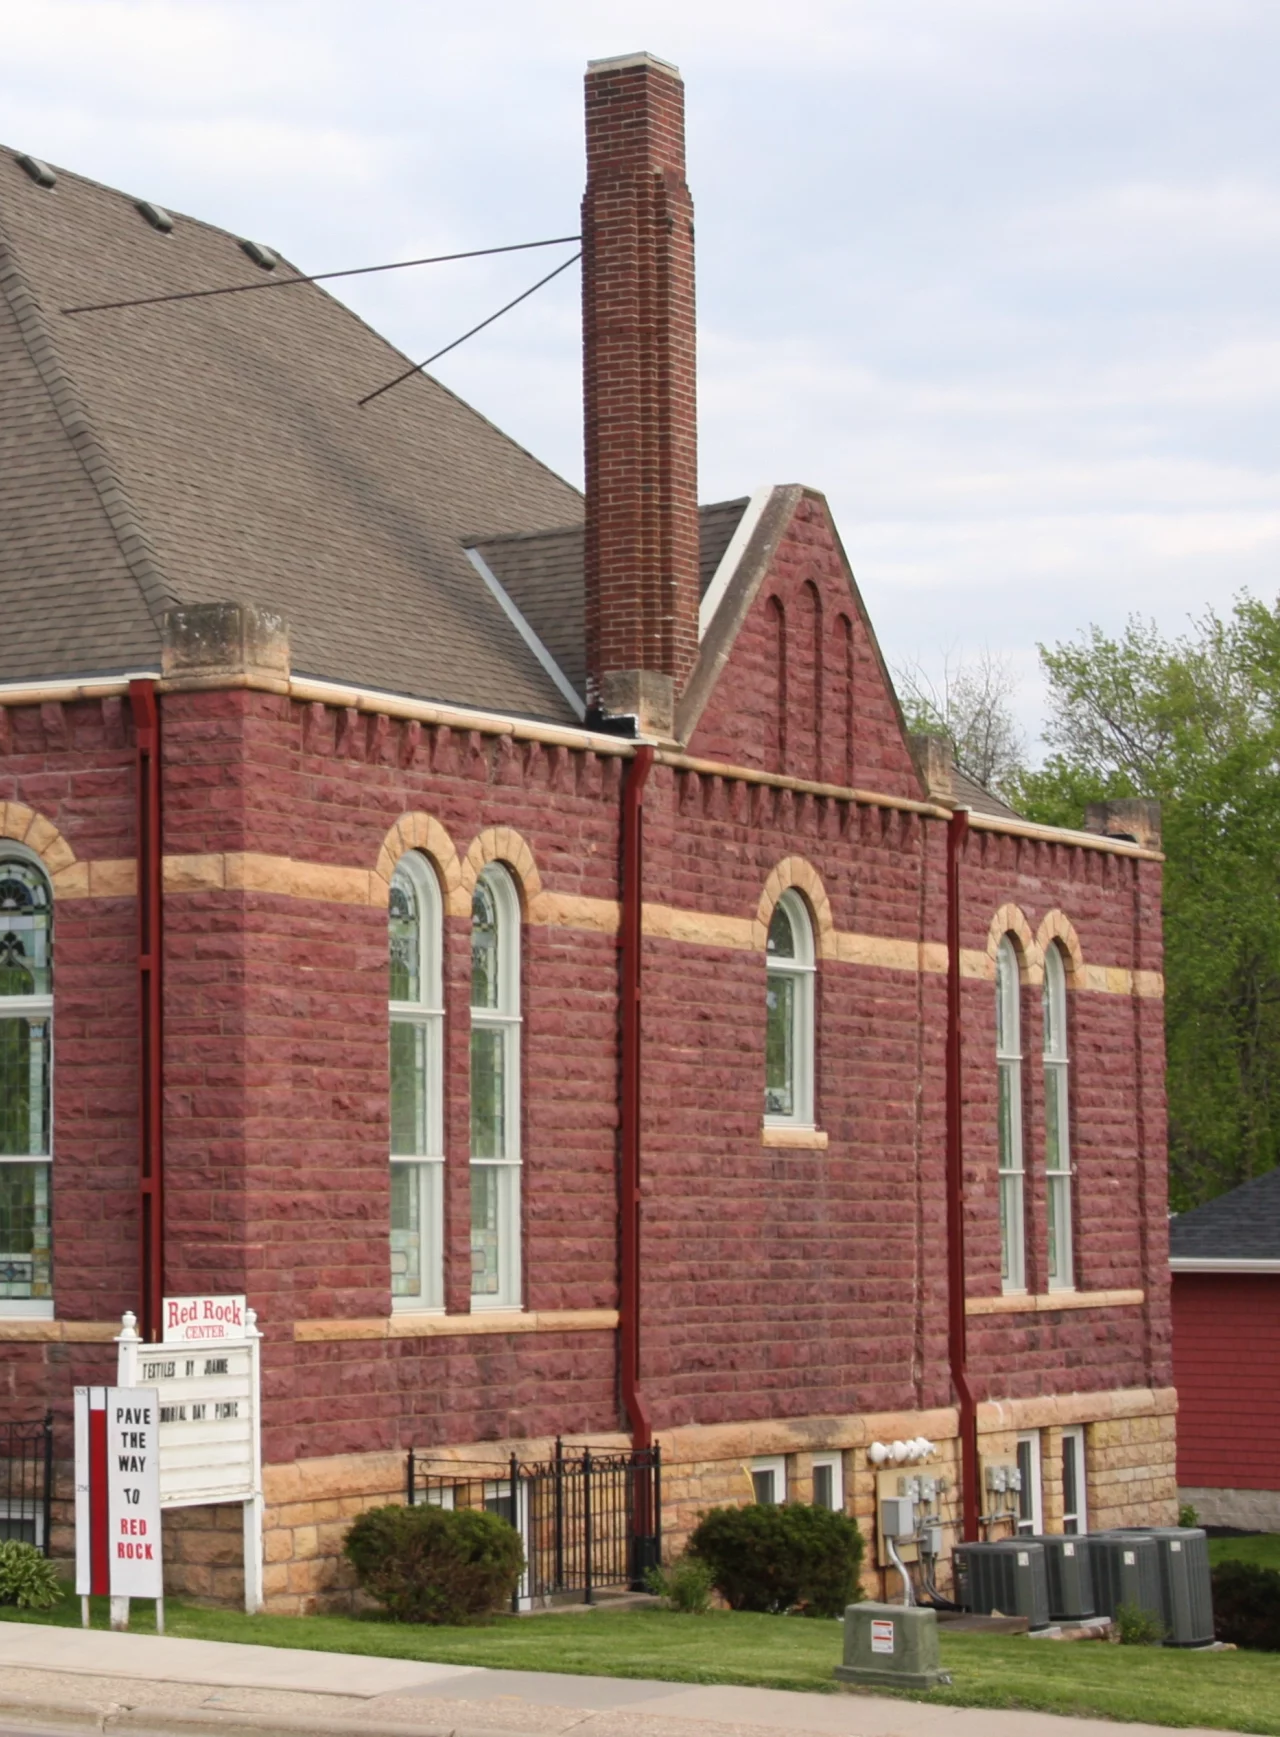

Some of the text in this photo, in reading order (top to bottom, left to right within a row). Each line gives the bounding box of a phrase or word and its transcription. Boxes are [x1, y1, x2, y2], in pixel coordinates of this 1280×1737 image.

[168, 1299, 242, 1329] Red Rock
[185, 1325, 225, 1340] CENTER
[143, 1361, 176, 1380] TEXTILES
[185, 1360, 195, 1377] BY
[116, 1407, 151, 1425] PAVE
[160, 1401, 239, 1423] MORIAL DAY PICNIC
[121, 1431, 147, 1449] THE
[118, 1455, 147, 1473] WAY
[123, 1488, 141, 1505] TO
[120, 1518, 148, 1536] RED
[117, 1541, 154, 1560] ROCK
